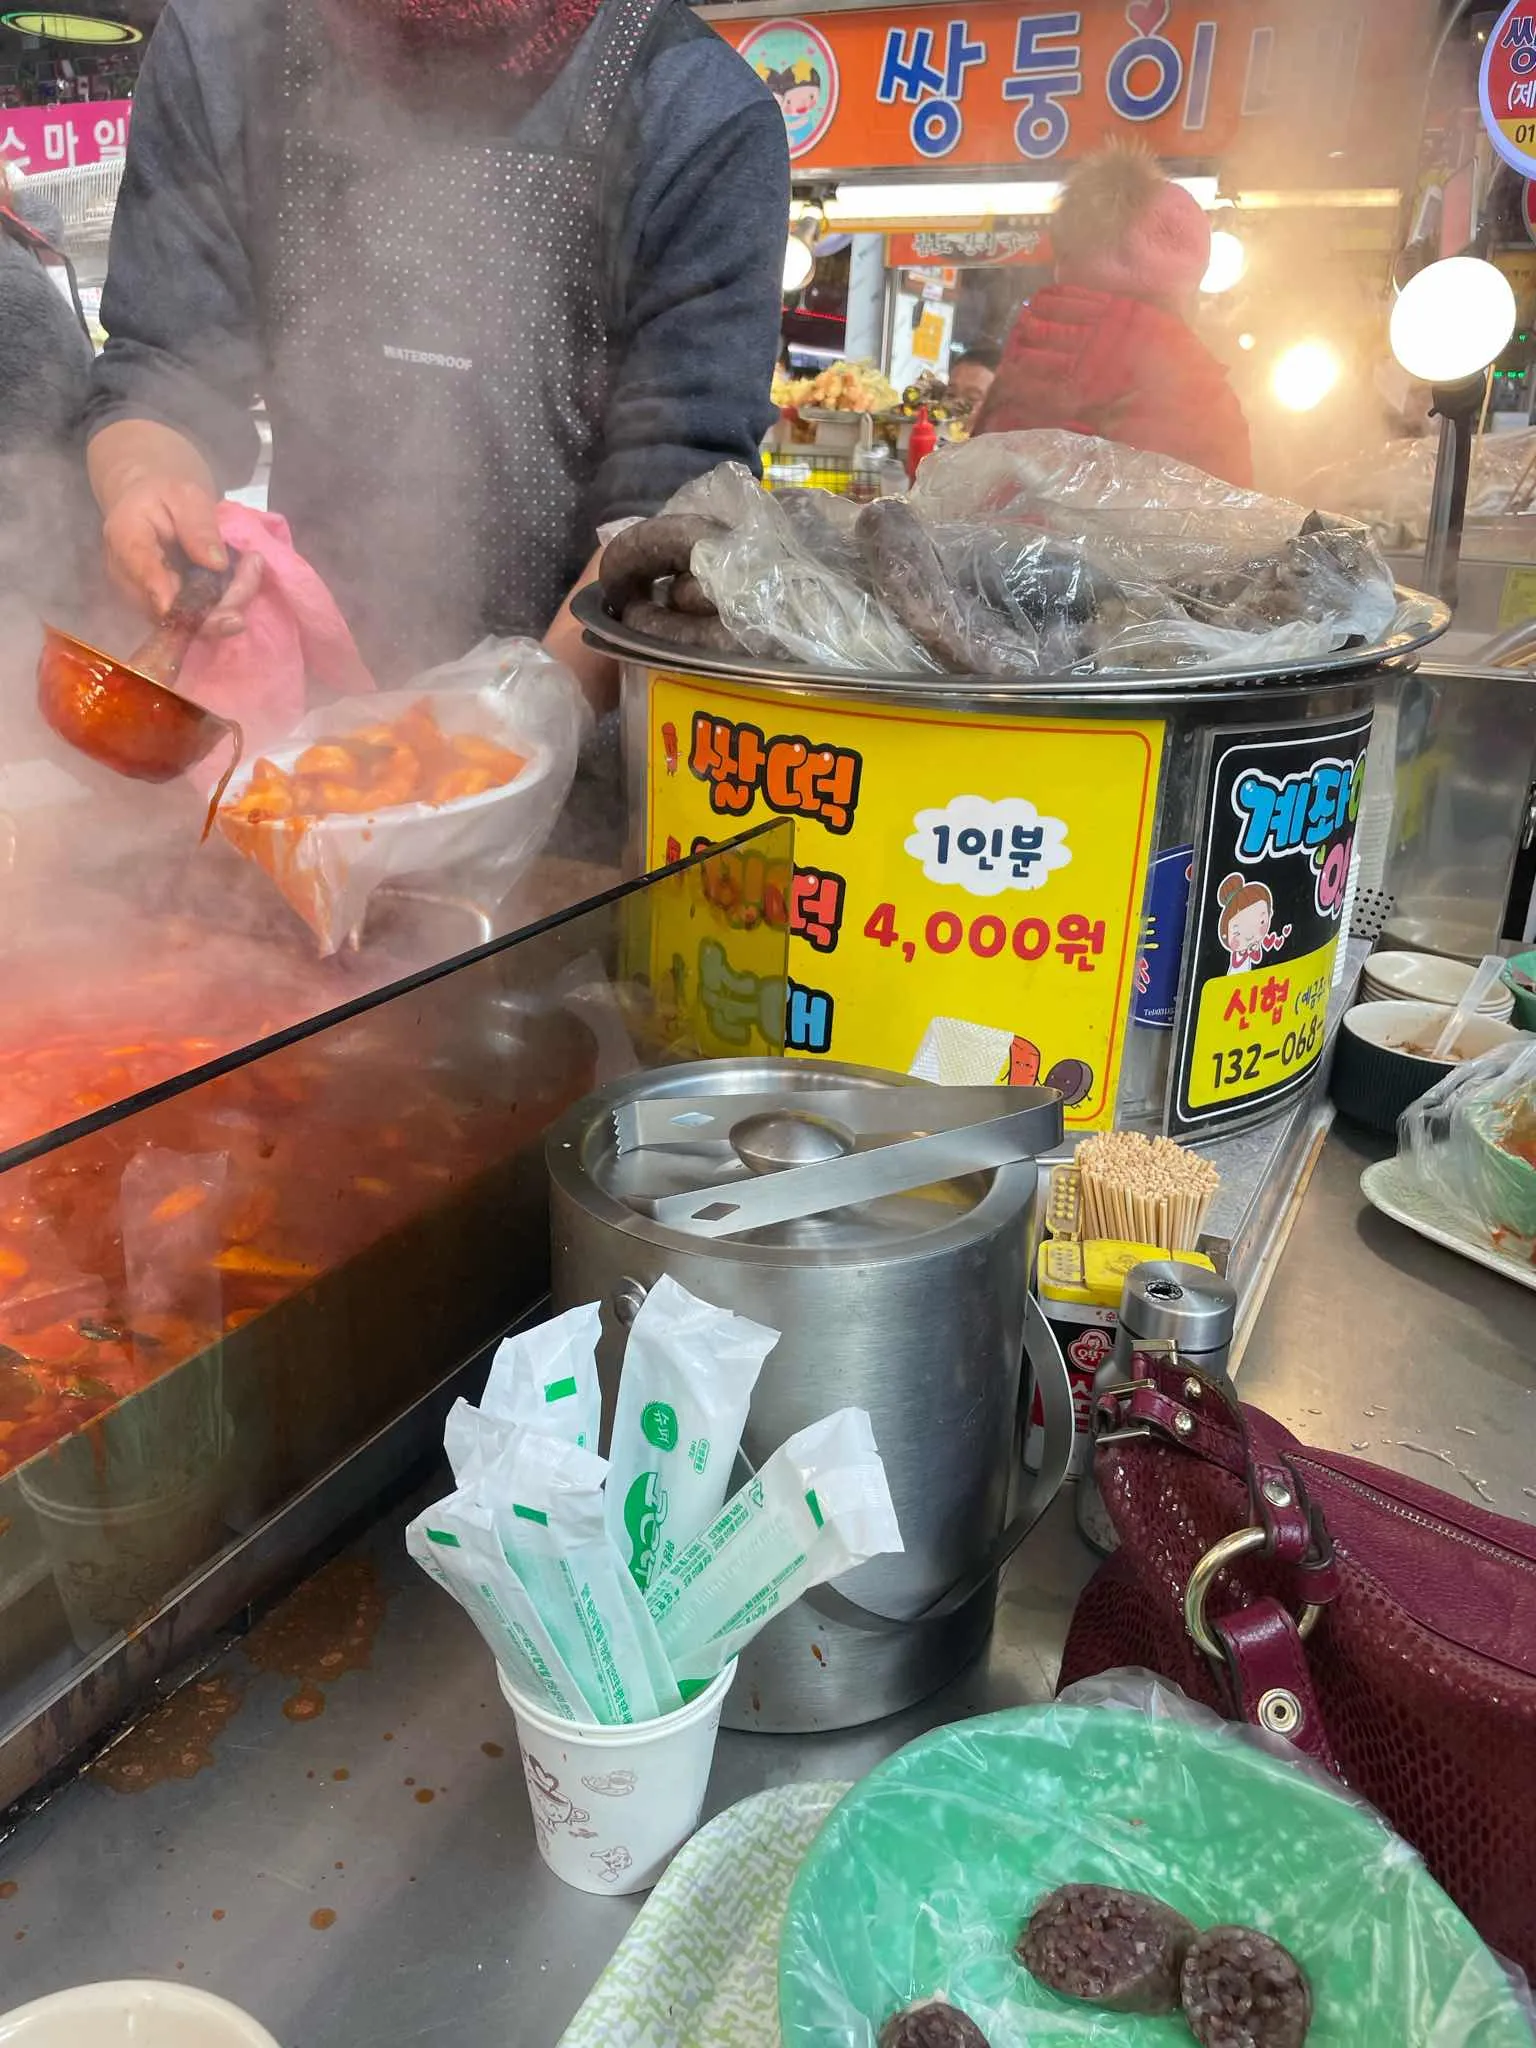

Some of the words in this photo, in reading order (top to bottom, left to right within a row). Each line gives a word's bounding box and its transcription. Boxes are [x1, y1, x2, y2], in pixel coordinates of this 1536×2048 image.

[877, 10, 1217, 158] 쌍둥이
[0, 117, 126, 169] 스마일
[383, 344, 473, 371] WATERPROOF
[688, 711, 863, 835] 쌀떡
[932, 824, 1045, 878] 1인분
[863, 902, 1107, 973] 4,000원
[1223, 976, 1290, 1031] 신협
